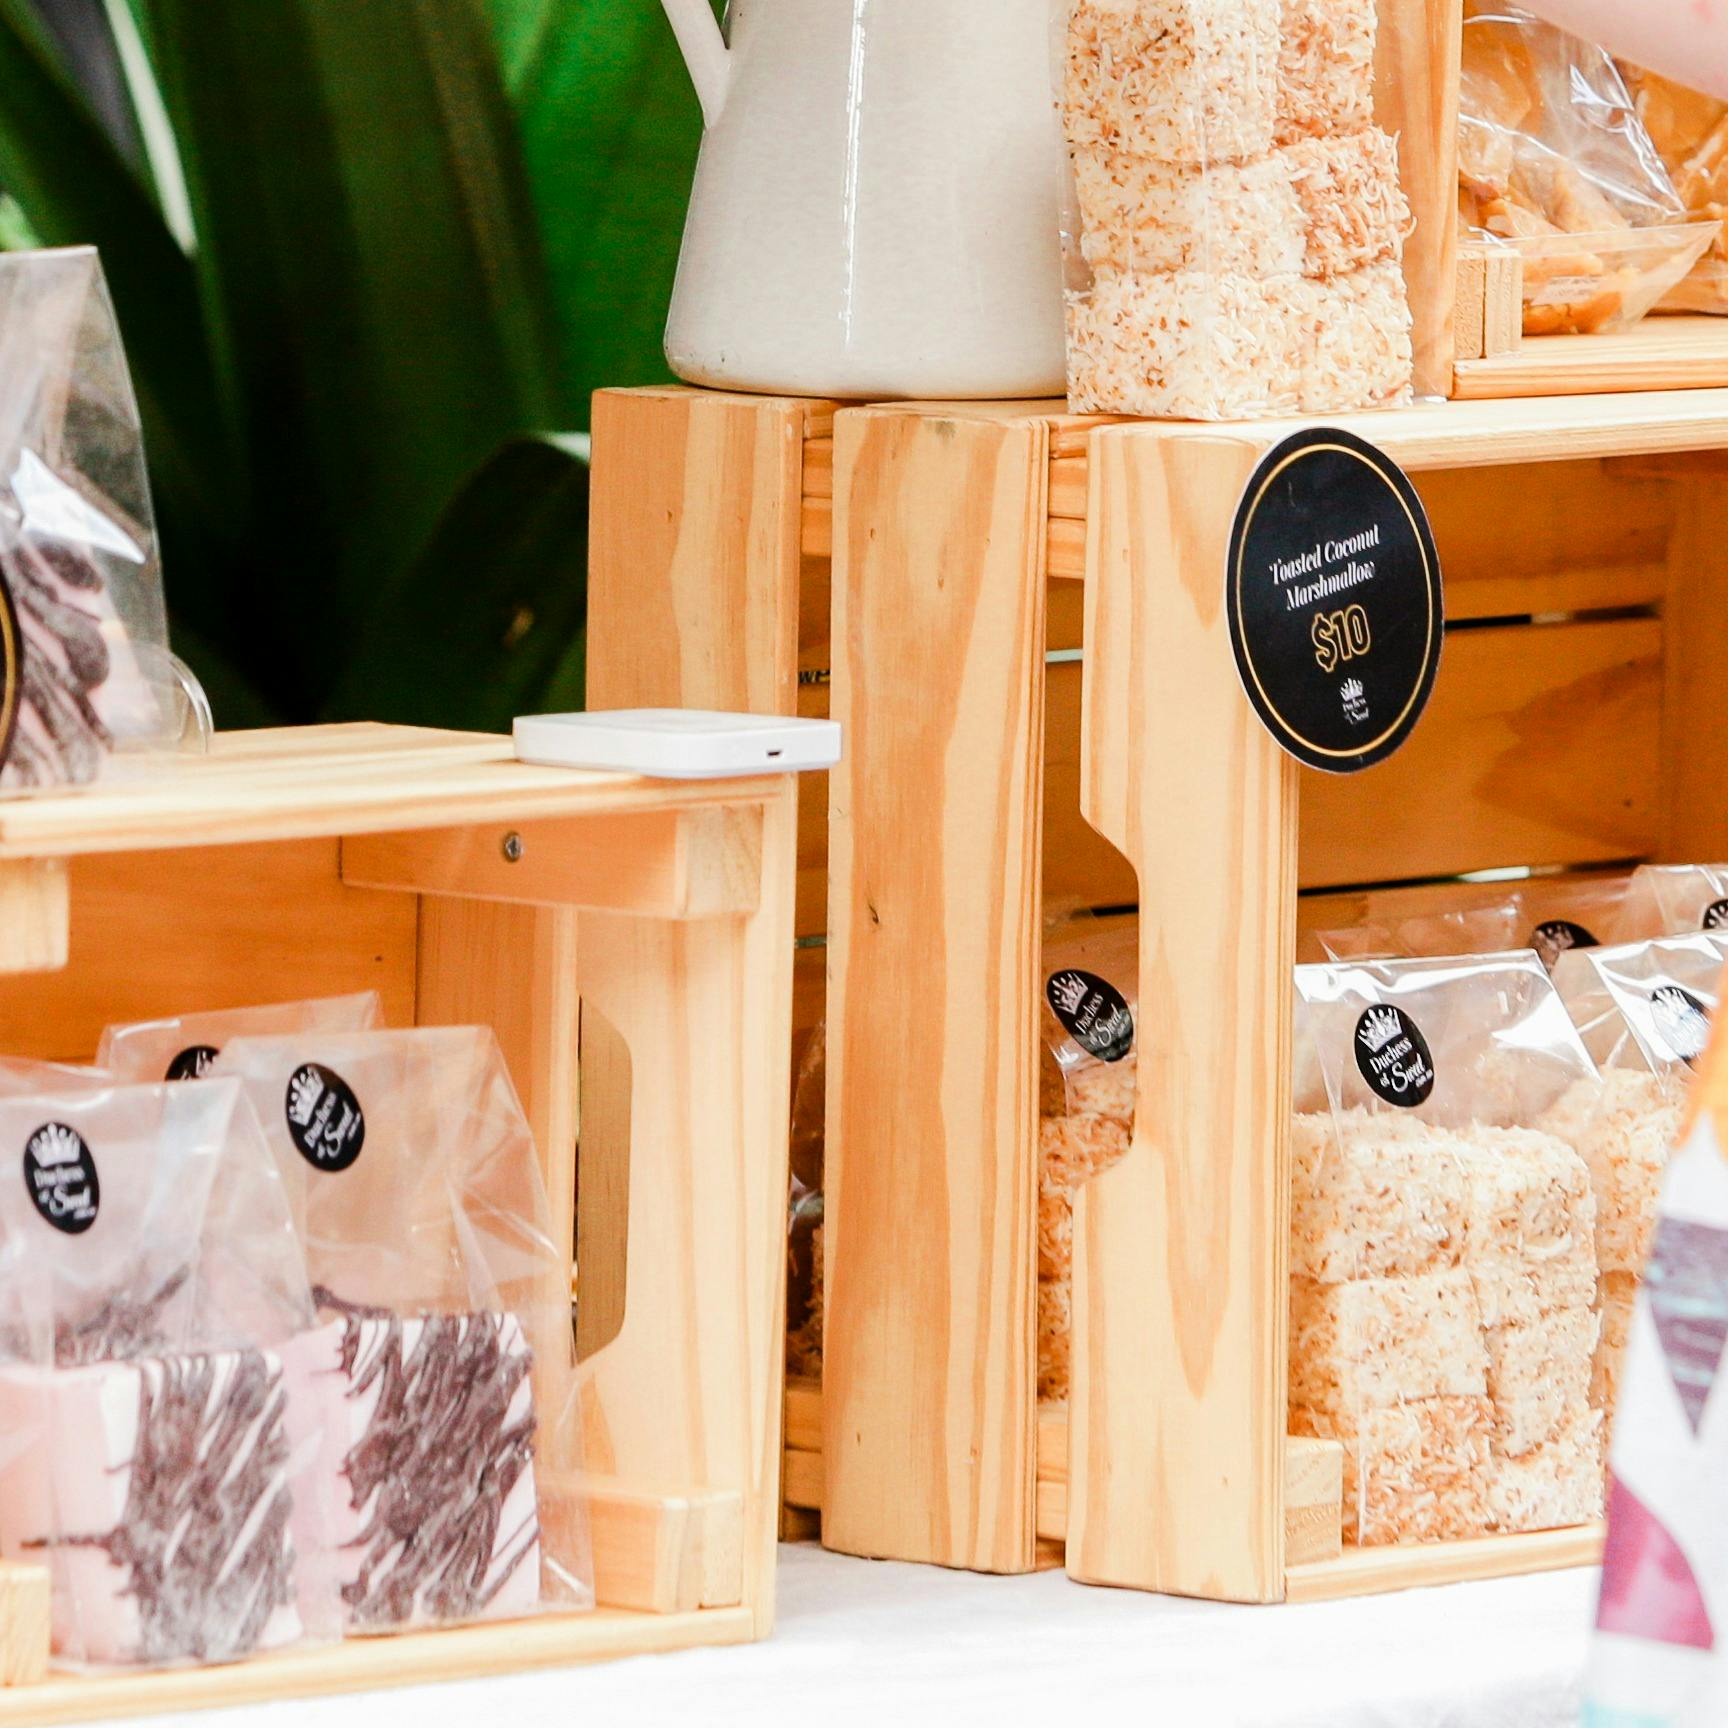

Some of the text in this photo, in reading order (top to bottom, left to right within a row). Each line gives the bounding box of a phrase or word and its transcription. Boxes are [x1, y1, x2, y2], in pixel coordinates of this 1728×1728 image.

[1269, 524, 1380, 585] Toasted Coconut
[1286, 561, 1376, 611] Marshmallow
[1311, 604, 1371, 672] $10
[1075, 992, 1104, 1034] Duchess
[1369, 1037, 1412, 1074] Duchess
[1391, 1053, 1426, 1092] Sweet
